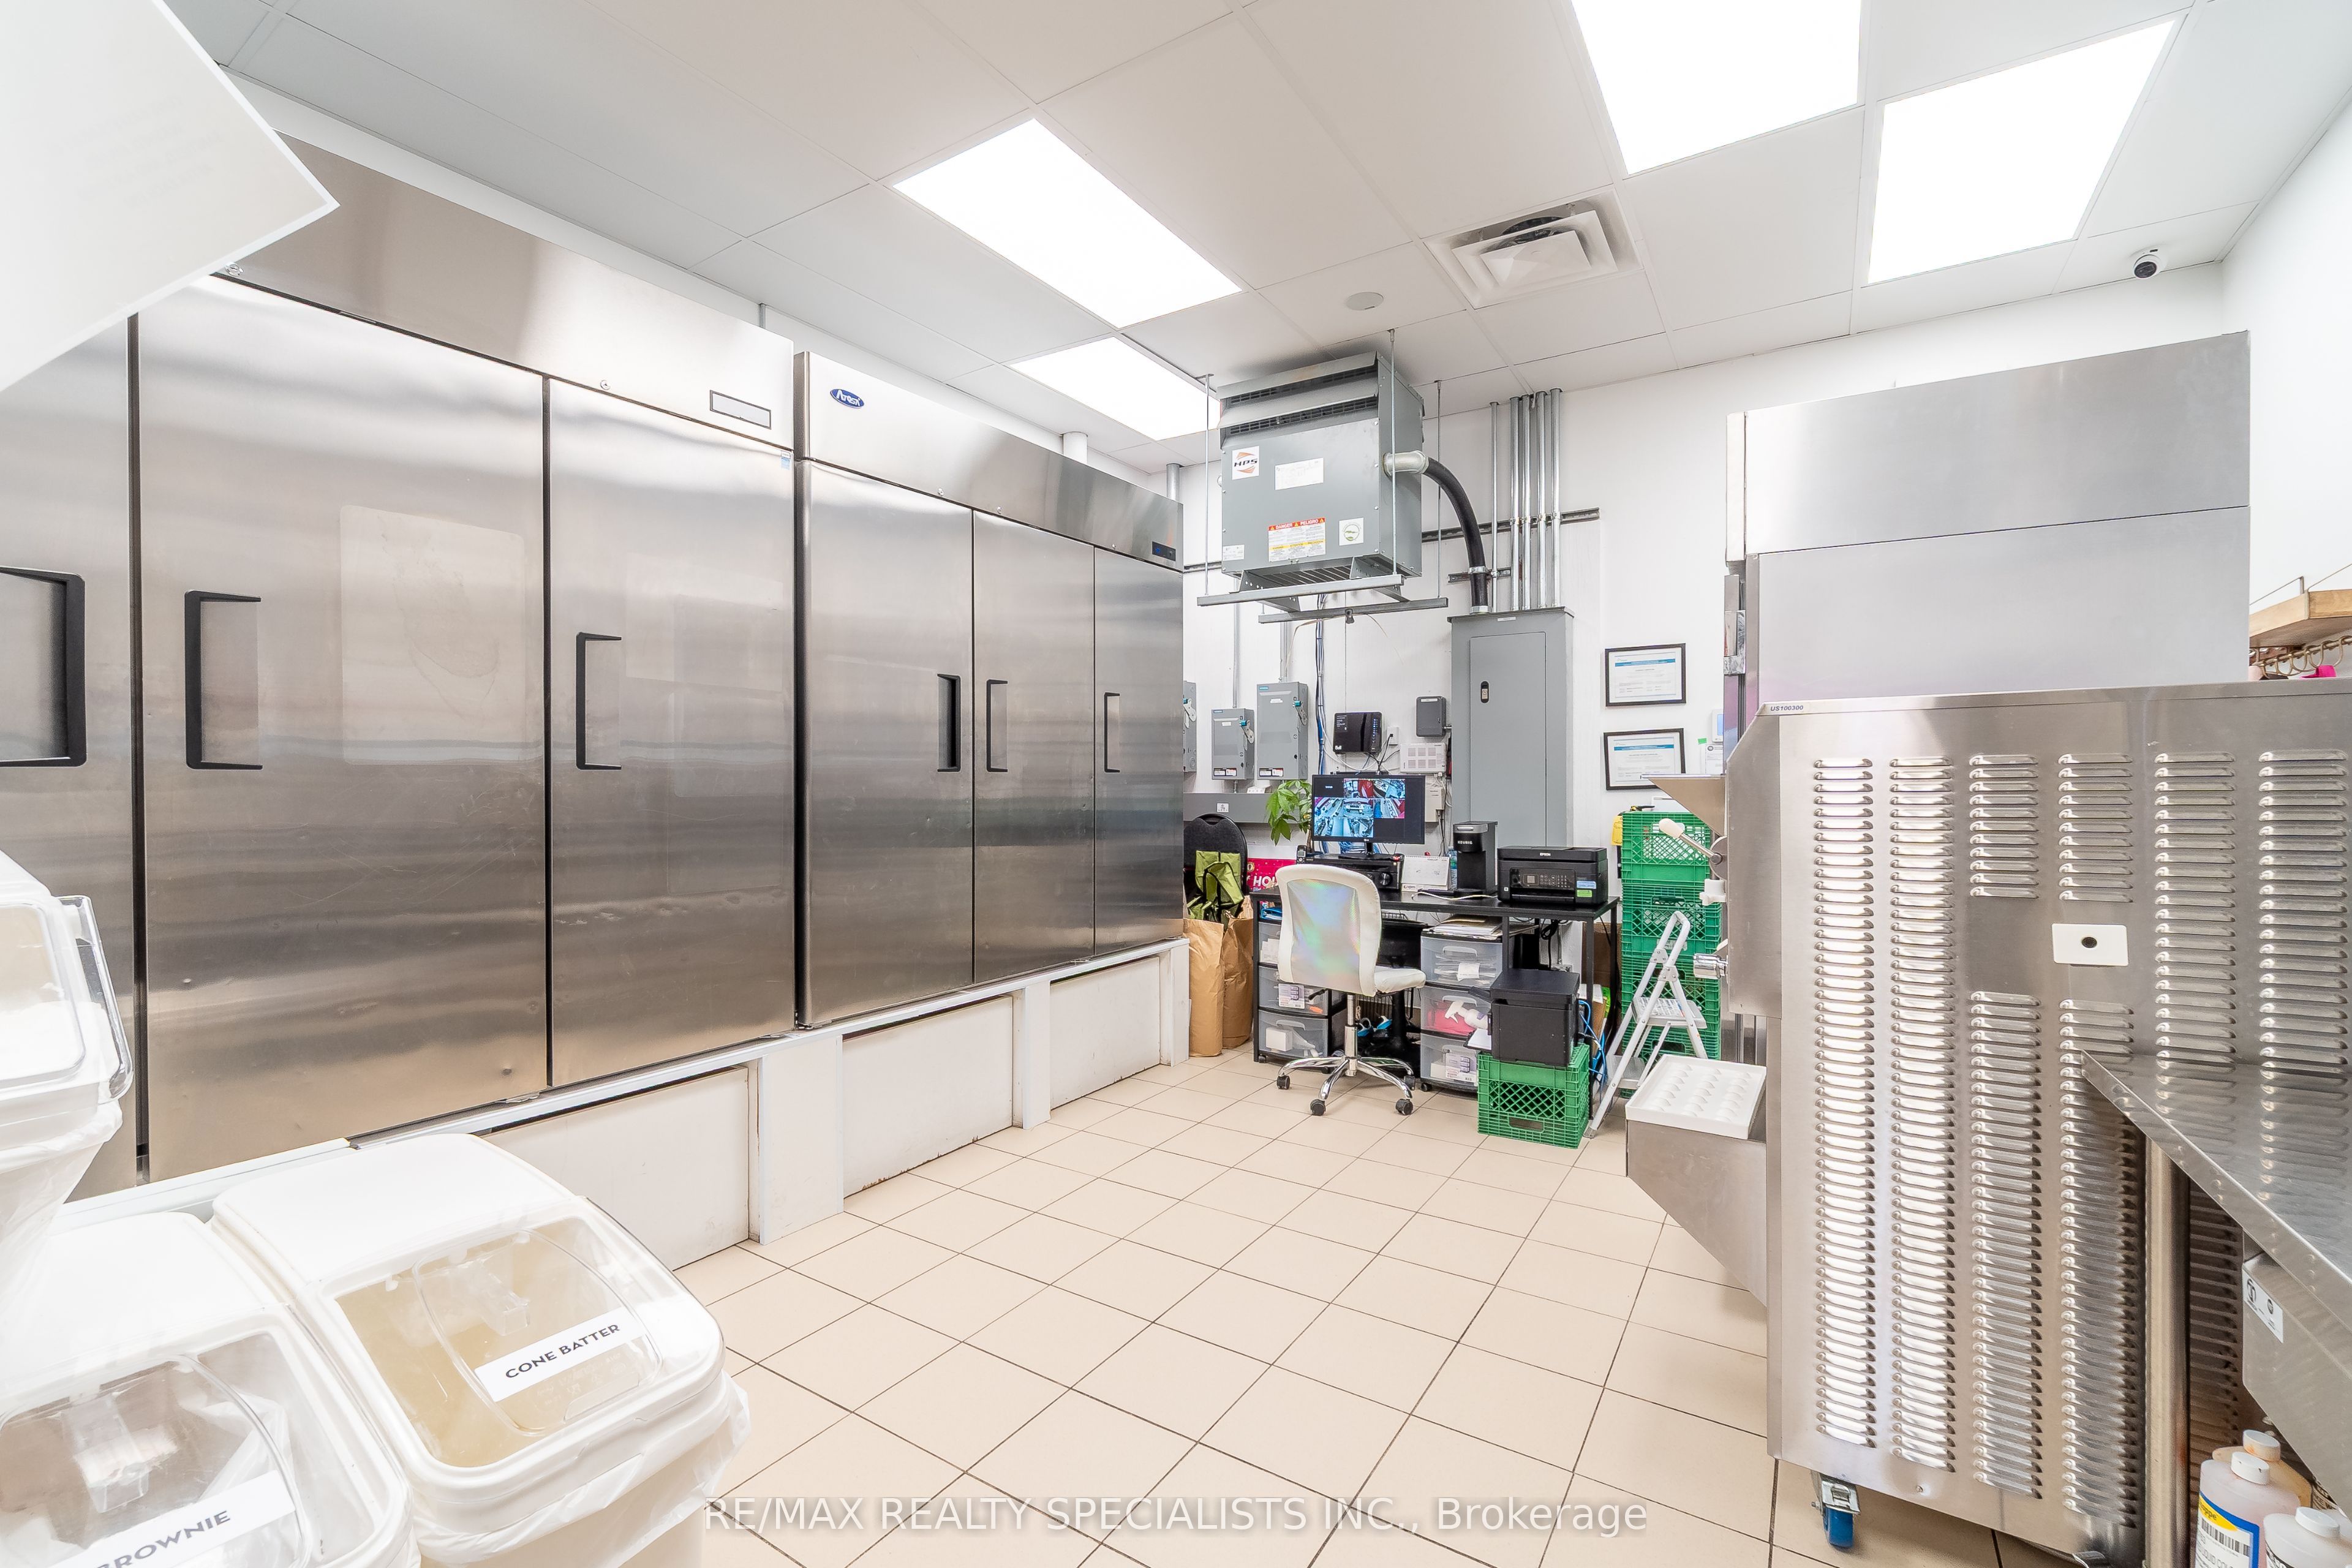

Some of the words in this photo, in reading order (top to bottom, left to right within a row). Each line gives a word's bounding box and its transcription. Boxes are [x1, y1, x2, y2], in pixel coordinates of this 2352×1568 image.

[1234, 458, 1258, 467] HPS
[505, 1351, 558, 1378] CONE
[559, 1324, 620, 1355] BATTER
